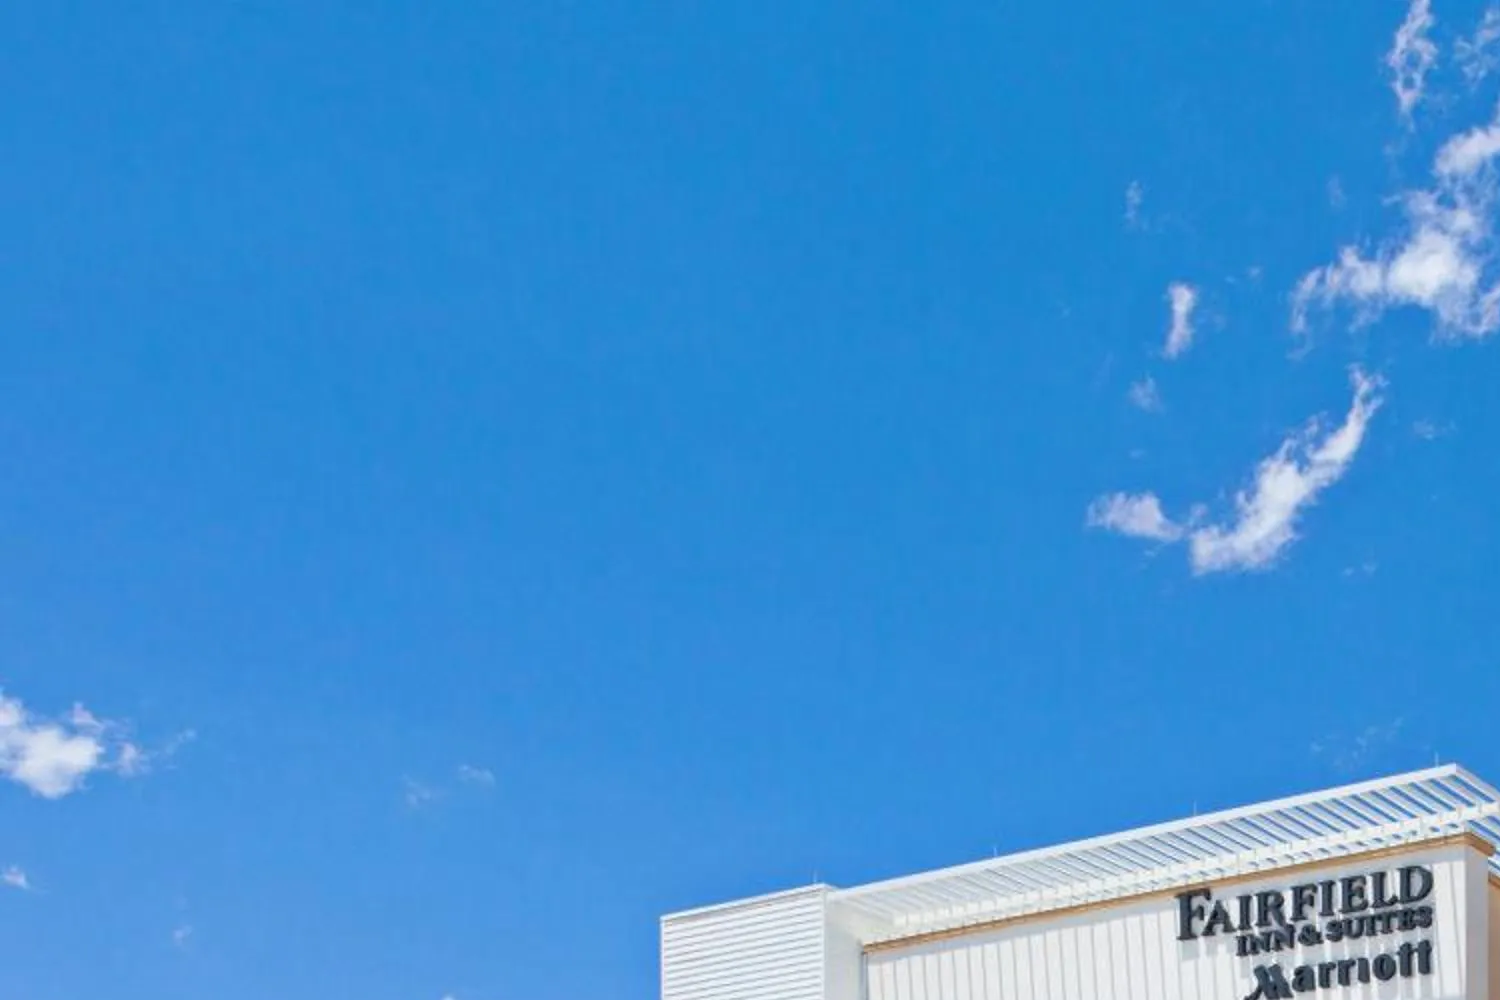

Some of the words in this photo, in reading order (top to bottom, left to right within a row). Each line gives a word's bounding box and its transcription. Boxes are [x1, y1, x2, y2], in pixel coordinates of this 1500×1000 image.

[1175, 865, 1434, 941] FAIRFIELD
[1235, 927, 1295, 957] INN
[1326, 906, 1433, 942] SUITES
